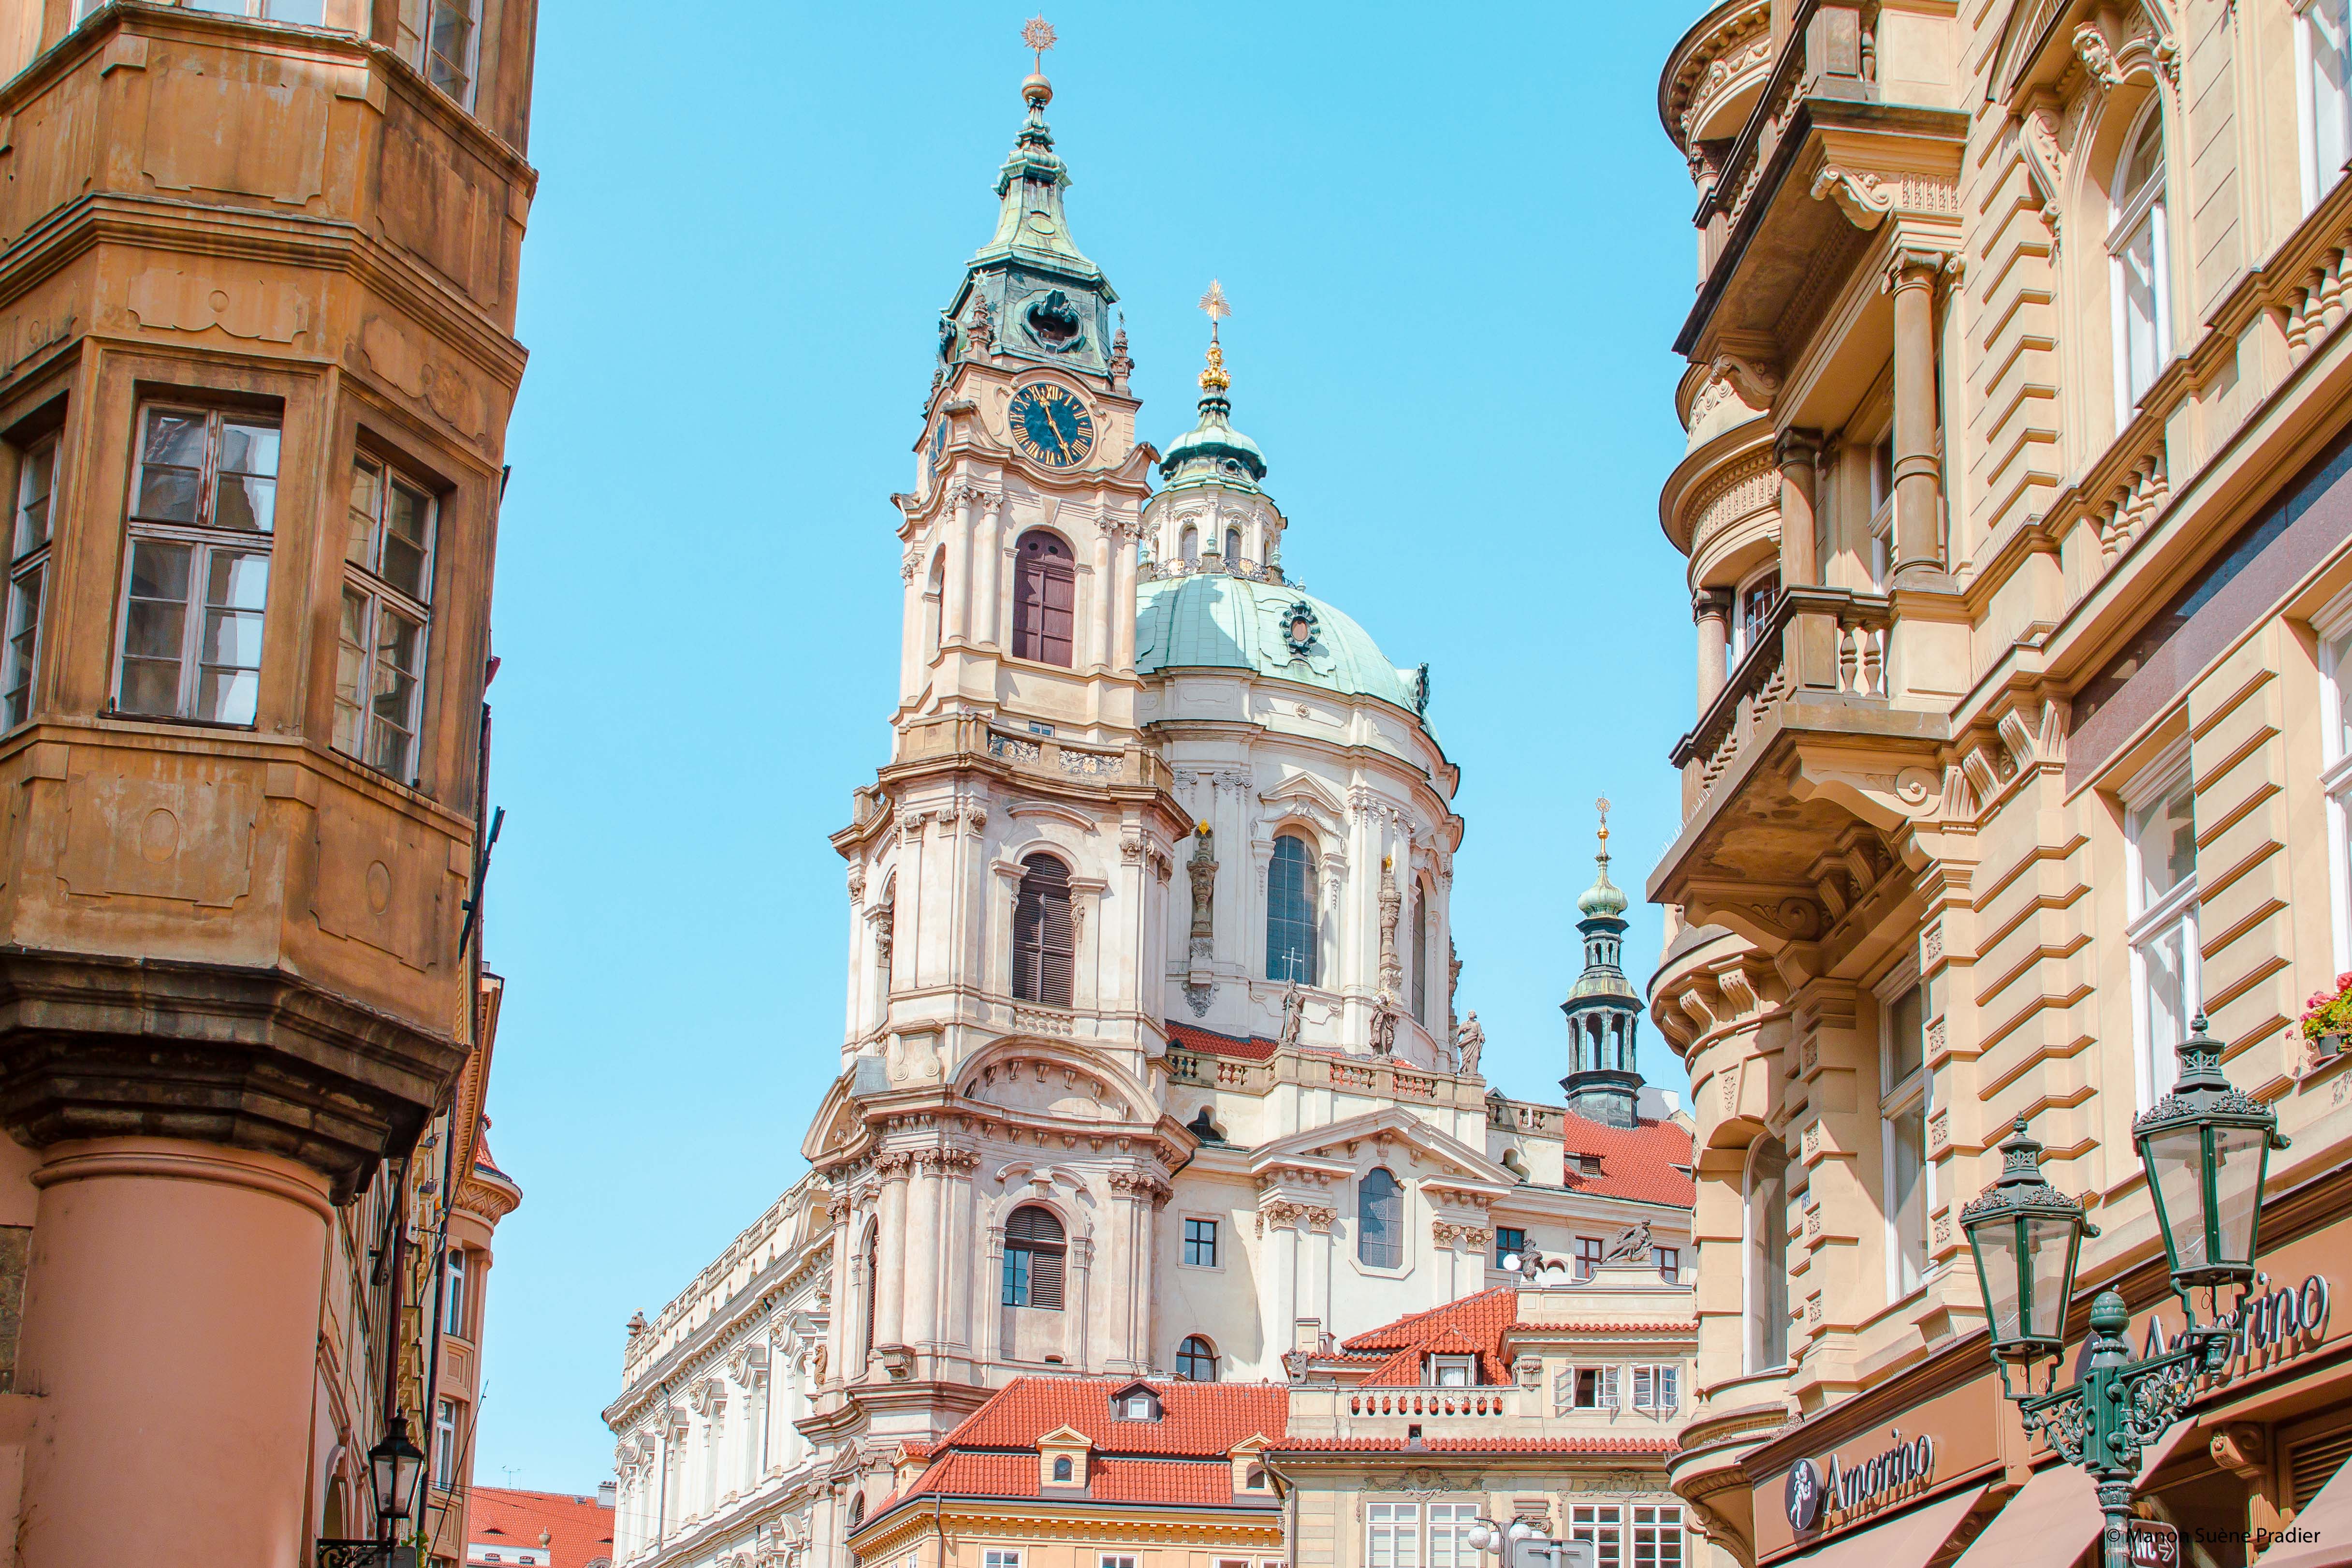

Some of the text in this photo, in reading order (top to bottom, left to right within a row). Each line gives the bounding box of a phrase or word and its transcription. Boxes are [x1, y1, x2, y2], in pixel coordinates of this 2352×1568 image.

[1045, 384, 1059, 401] XII
[1822, 1428, 1933, 1517] Amorino
[2133, 1531, 2158, 1560] WC
